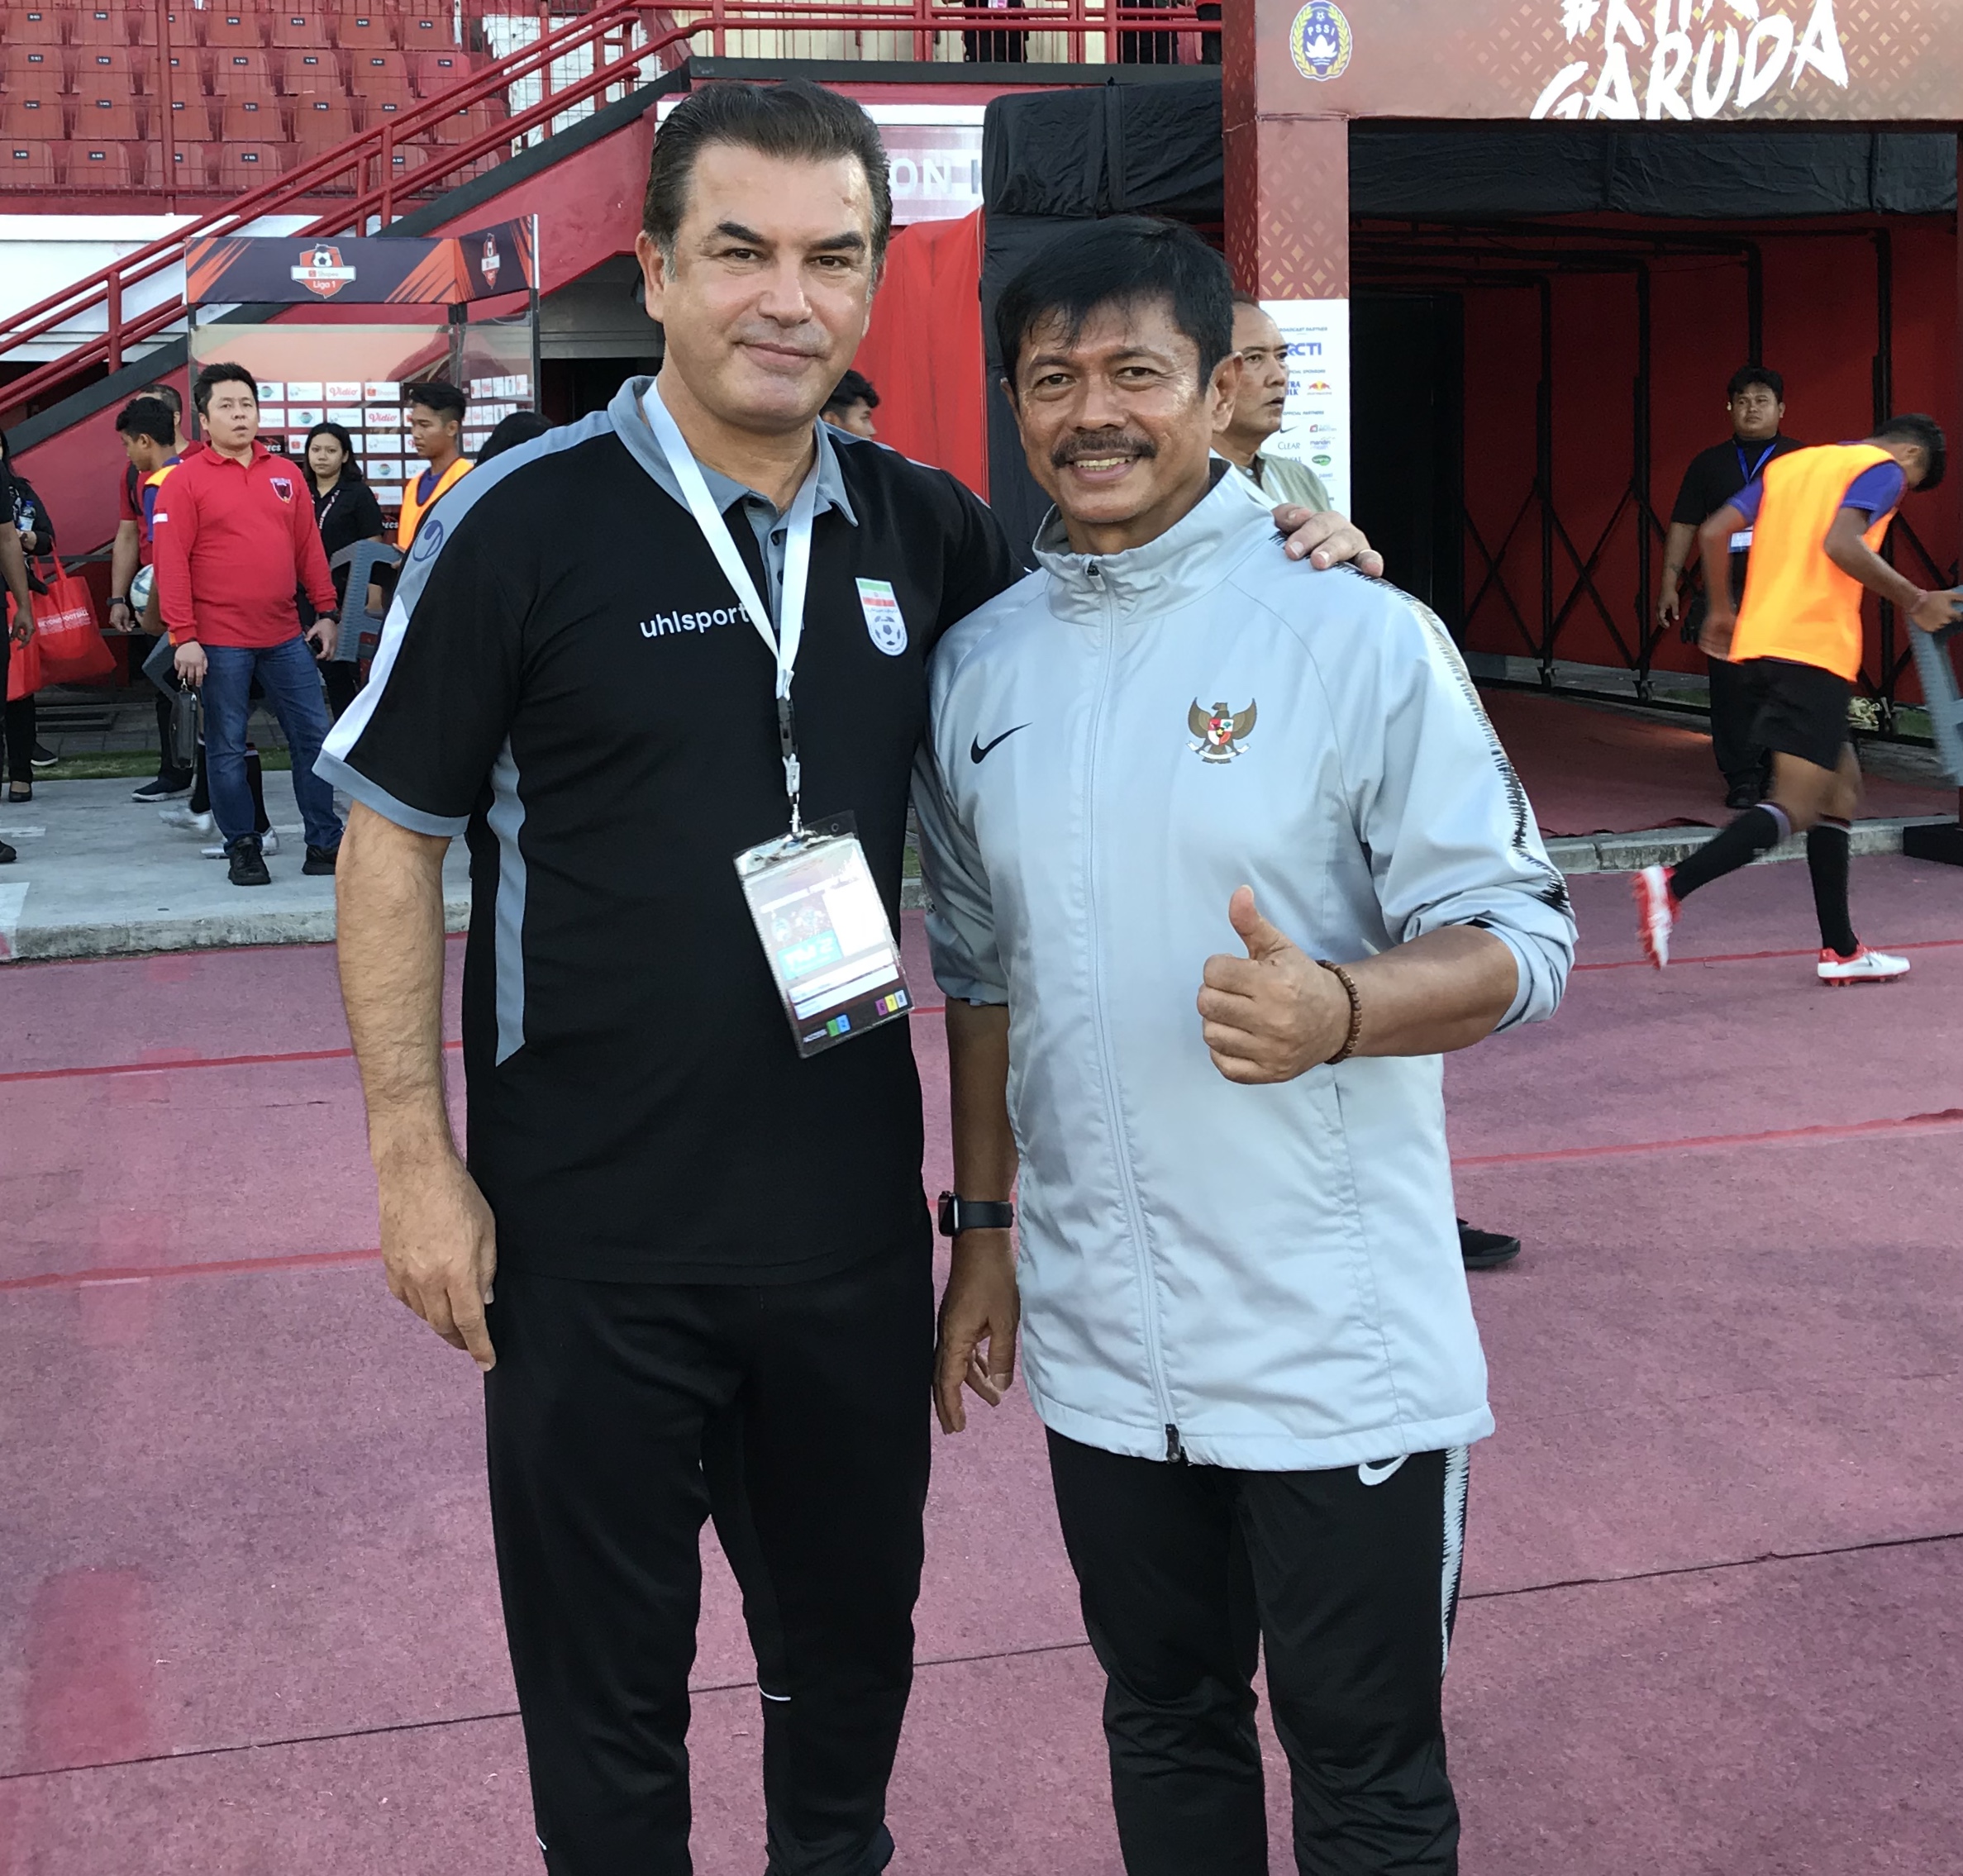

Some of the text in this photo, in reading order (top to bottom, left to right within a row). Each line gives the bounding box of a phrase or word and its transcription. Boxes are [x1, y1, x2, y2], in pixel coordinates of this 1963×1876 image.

[1307, 24, 1336, 36] PSSI
[1529, 0, 1849, 120] GARUDA
[313, 281, 330, 289] Liga
[330, 385, 358, 397] Vidio
[369, 412, 398, 422] Vidio
[1278, 441, 1301, 450] CLEAR
[640, 602, 750, 638] uhlsport
